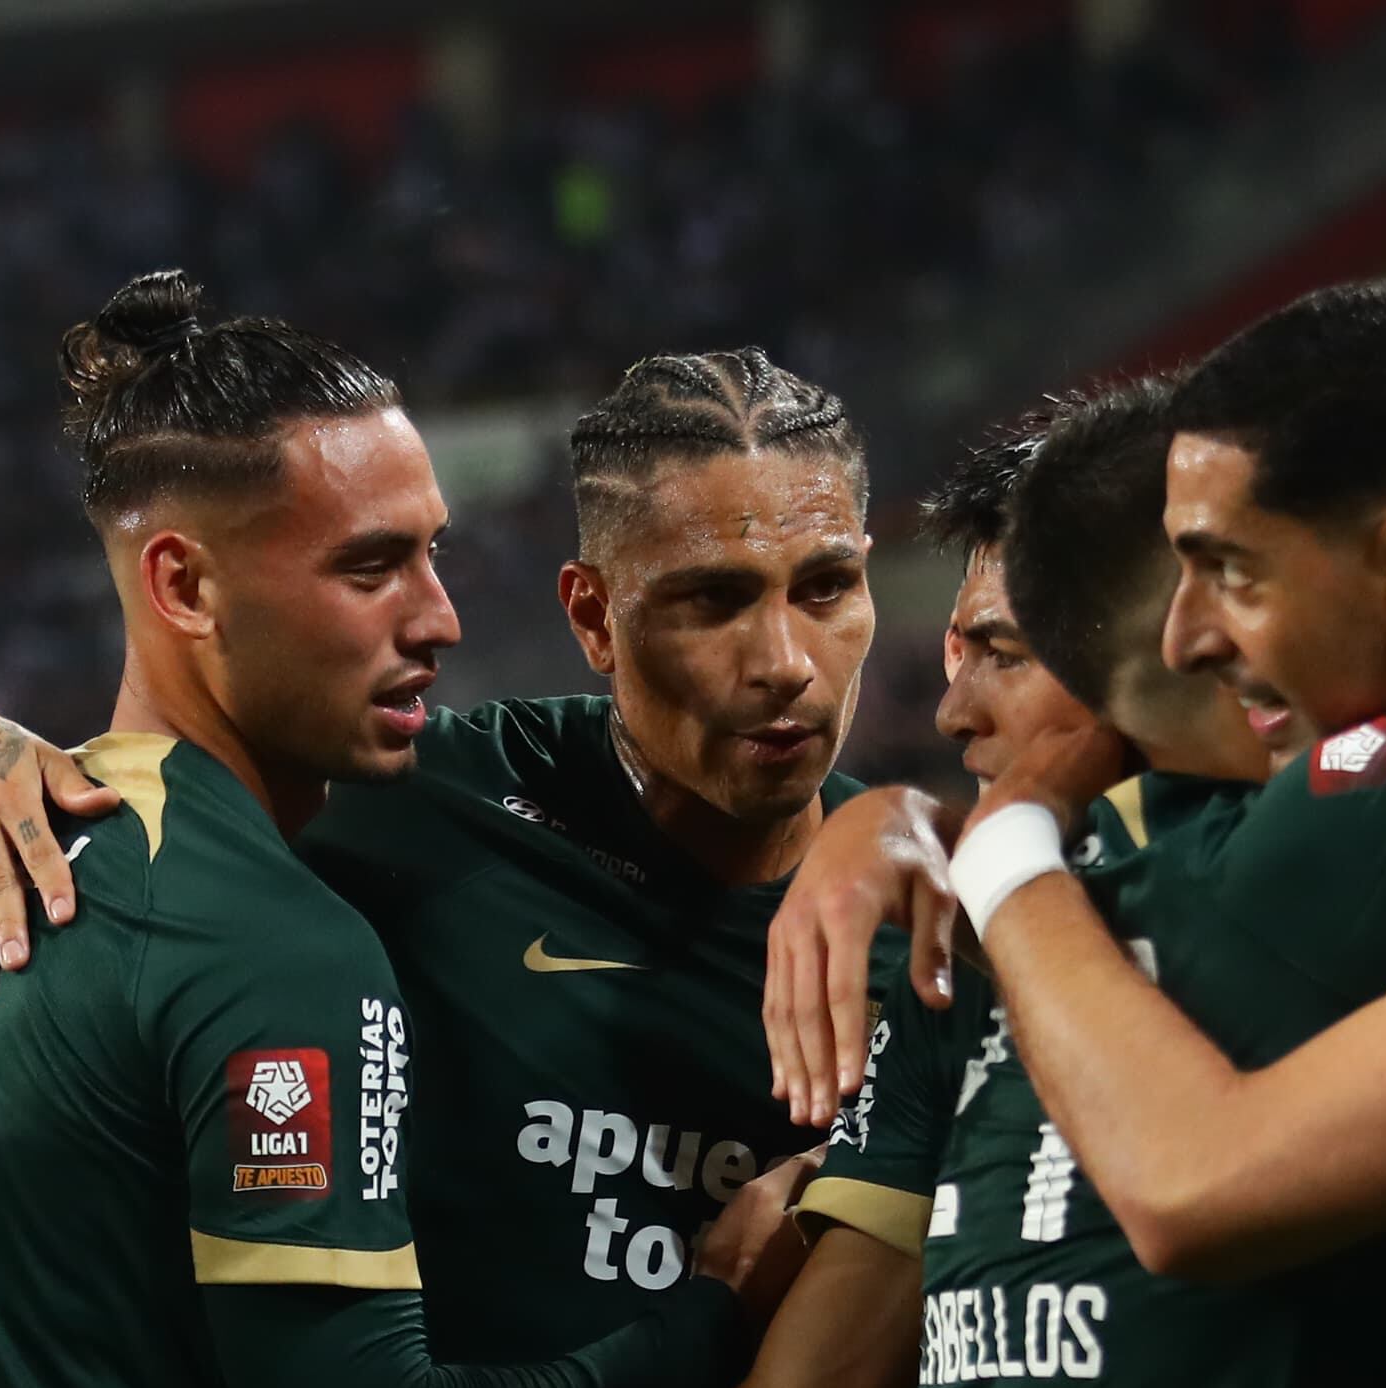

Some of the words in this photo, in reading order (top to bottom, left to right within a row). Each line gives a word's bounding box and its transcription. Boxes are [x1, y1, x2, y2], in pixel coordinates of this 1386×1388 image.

[250, 1130, 296, 1157] LIGA
[359, 998, 384, 1201] LOTERÍAS
[380, 1006, 410, 1199] TORITO
[516, 1099, 757, 1204] apue
[236, 1167, 255, 1187] TE
[258, 1165, 325, 1187] APUESTO
[918, 1283, 1110, 1386] ABELLOS
